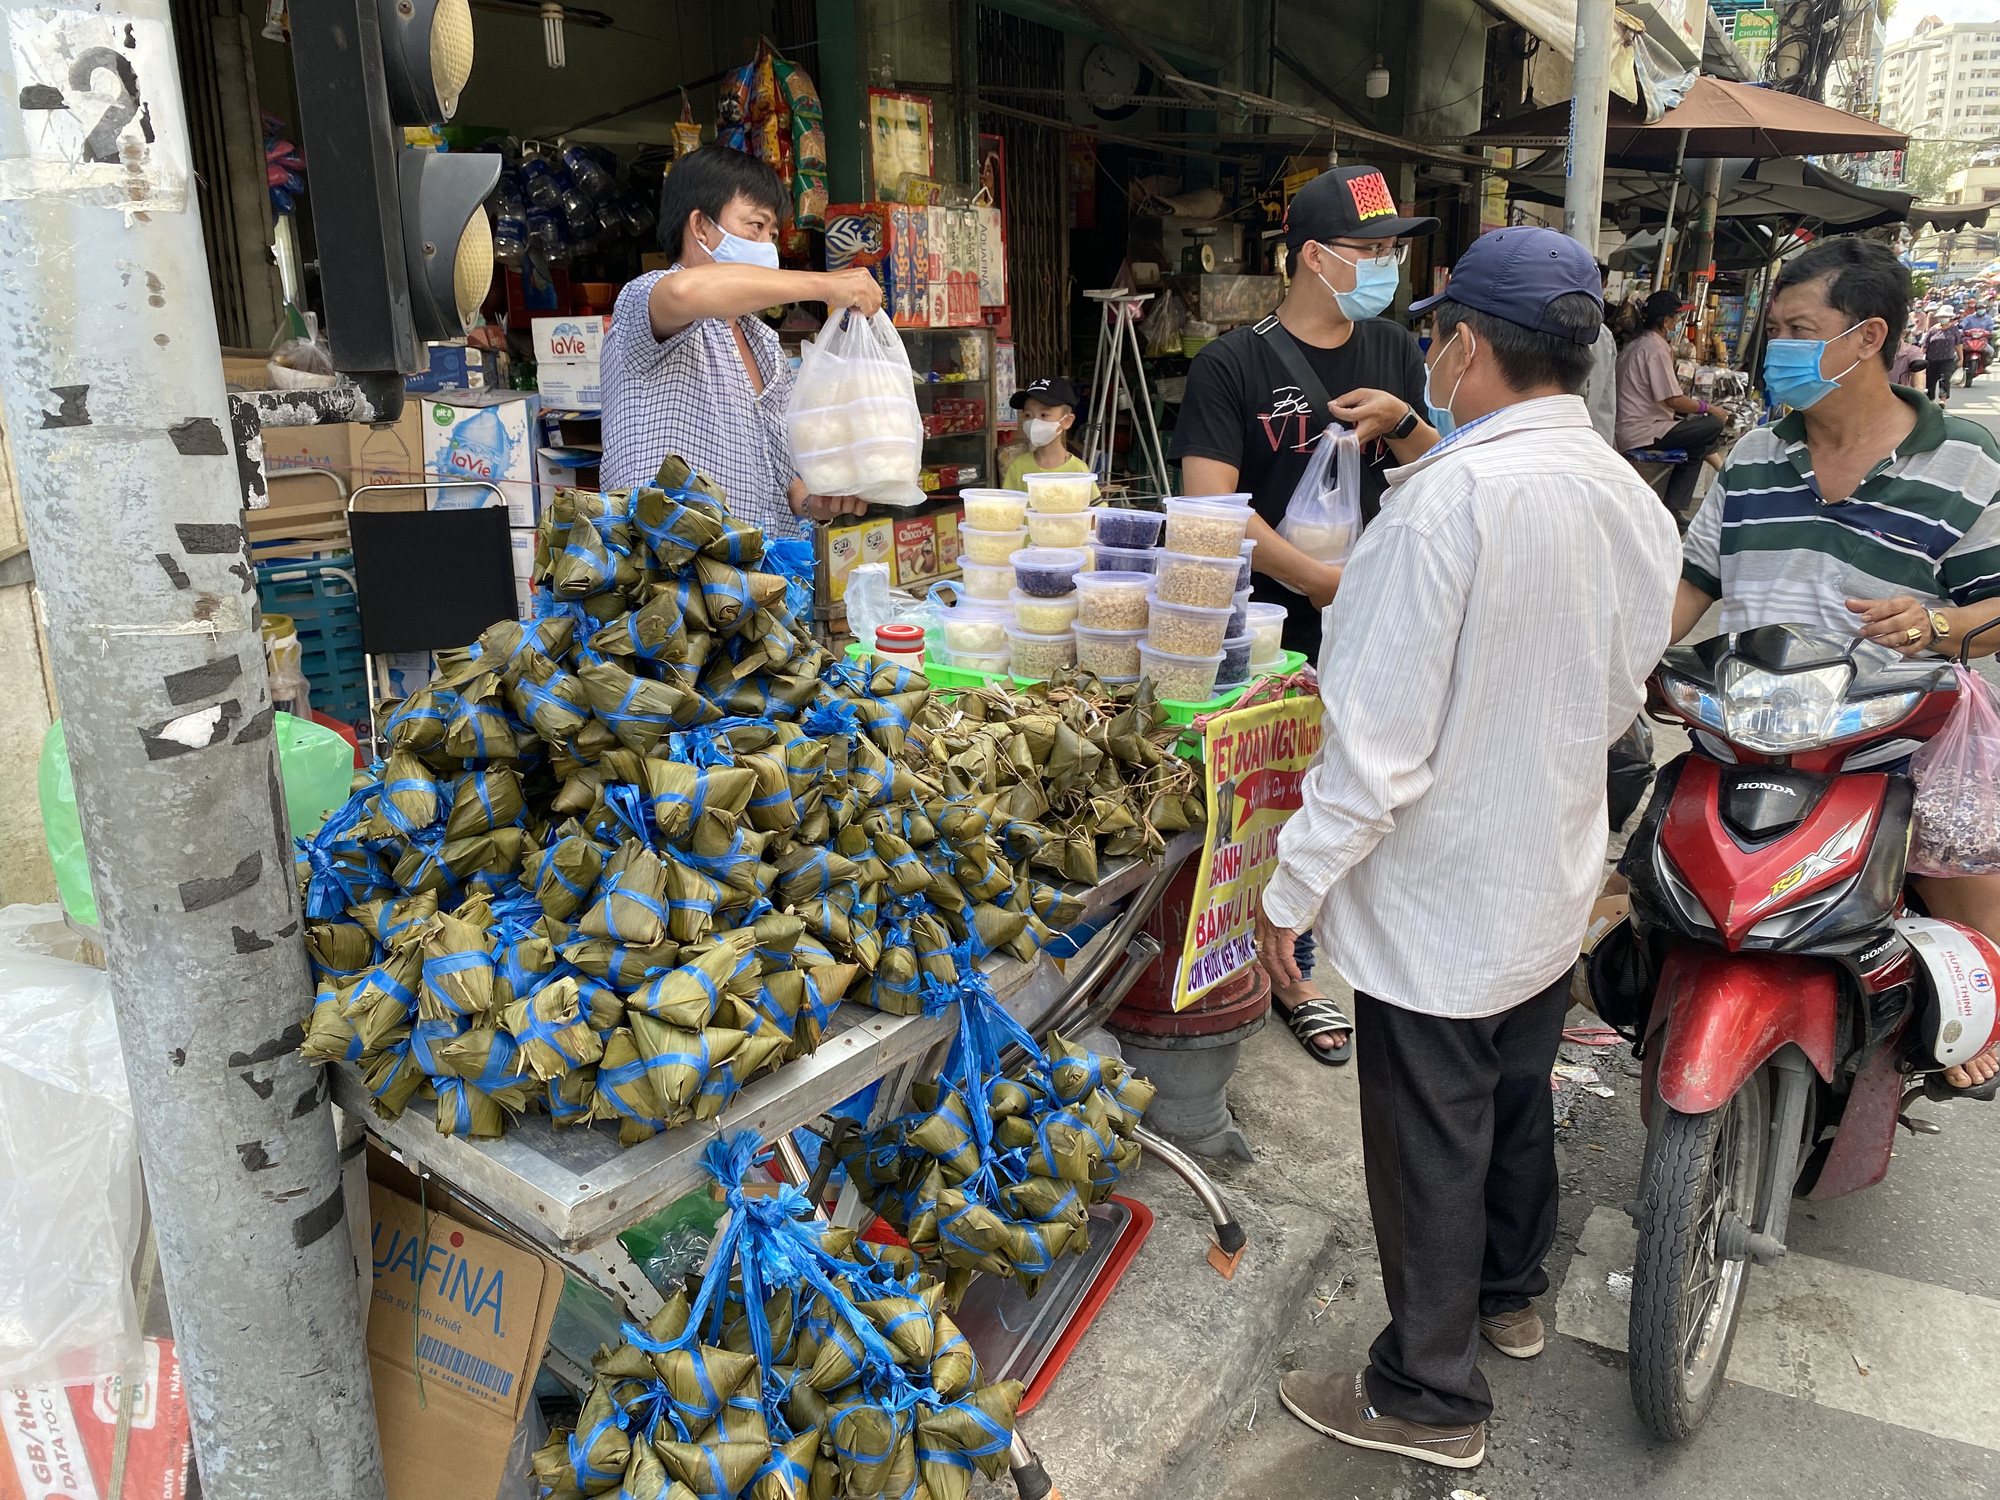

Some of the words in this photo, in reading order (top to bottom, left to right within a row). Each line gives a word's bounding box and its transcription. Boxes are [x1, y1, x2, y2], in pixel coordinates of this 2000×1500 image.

[1740, 13, 1774, 29] Shop
[894, 232, 910, 292] Tiger
[913, 233, 929, 294] Tiger
[979, 223, 989, 288] AQUAFINA
[551, 336, 586, 354] laVie
[451, 451, 492, 478] laVie
[1212, 720, 1234, 786] TẾT
[1736, 782, 1797, 797] HONDA
[1196, 898, 1233, 950] BÁNH
[1859, 936, 1898, 963] HONDA
[372, 1221, 504, 1335] UAFINA
[434, 1313, 463, 1335] khiết
[40, 1397, 61, 1435] TỐC
[51, 1437, 78, 1490] DATA
[163, 1468, 175, 1500] DATA
